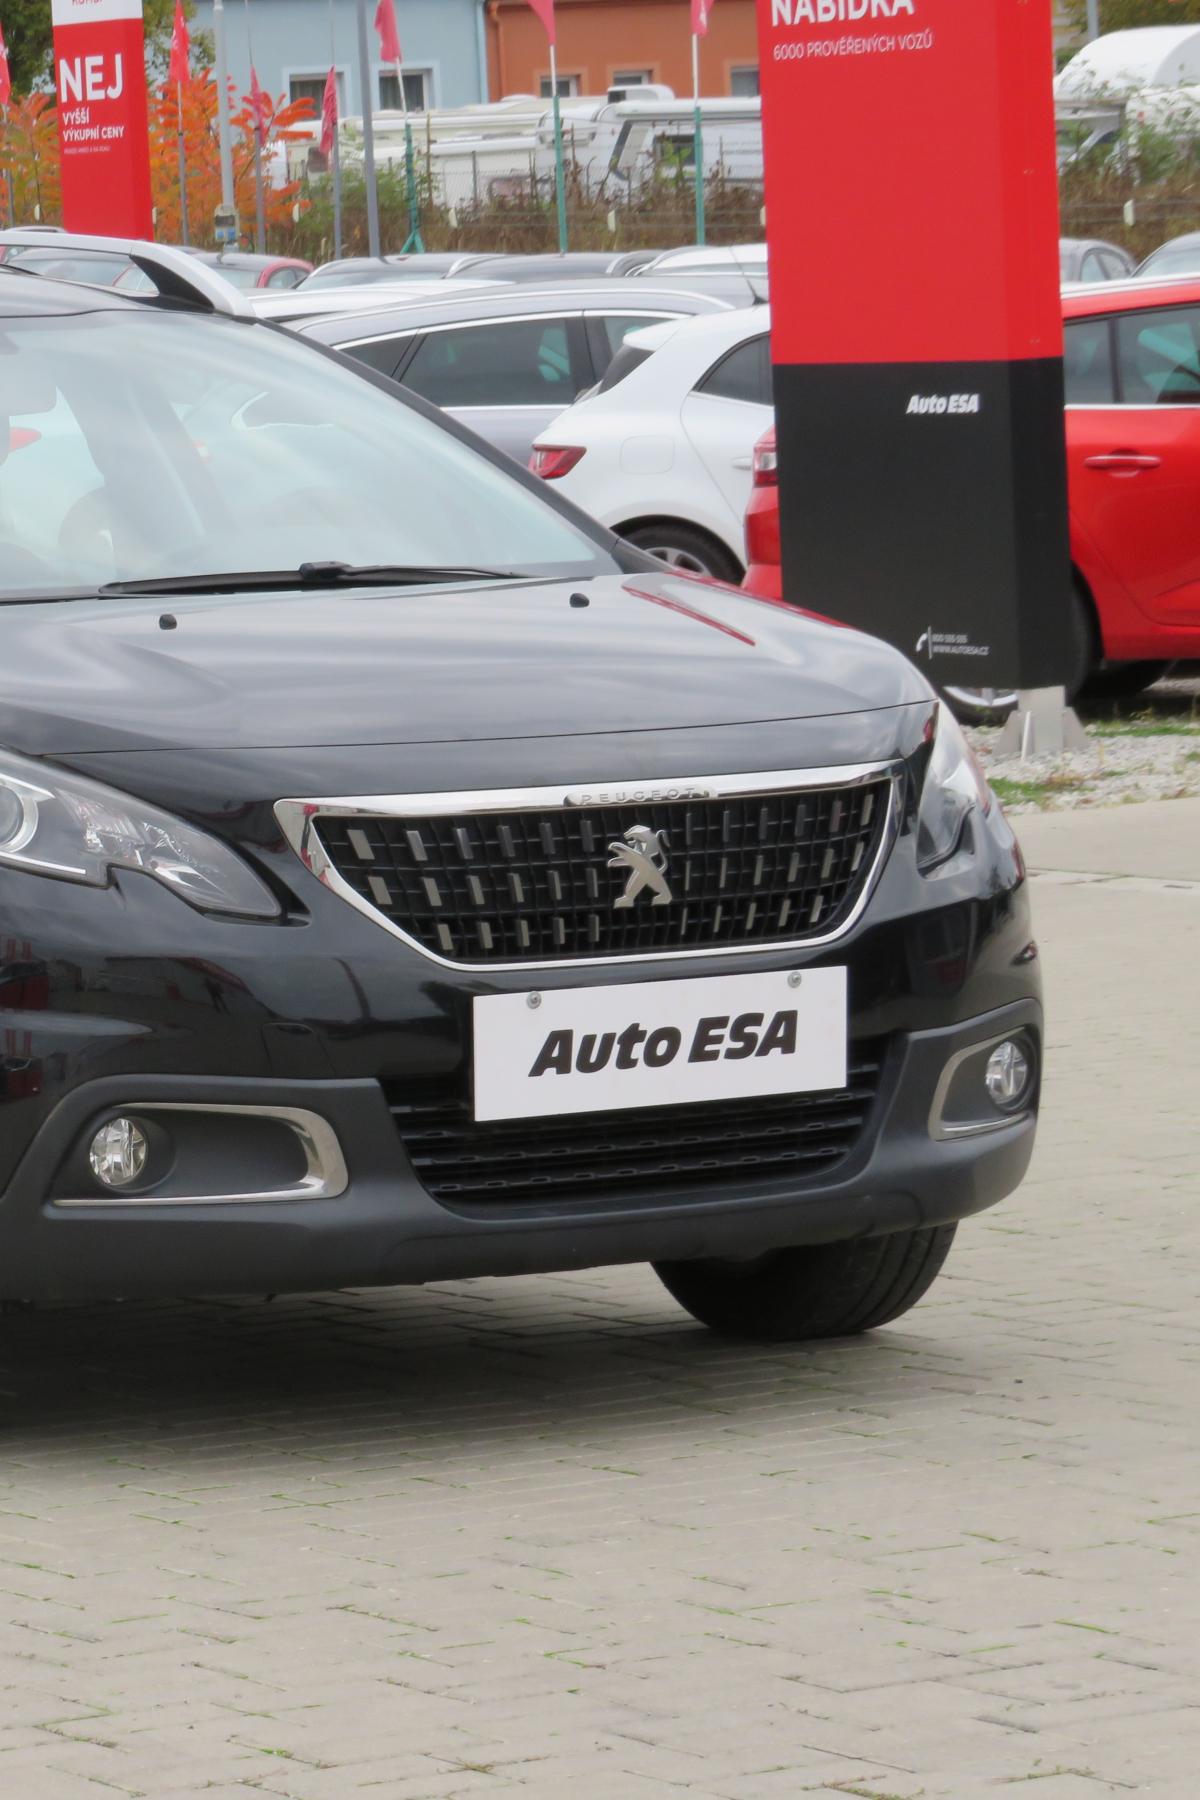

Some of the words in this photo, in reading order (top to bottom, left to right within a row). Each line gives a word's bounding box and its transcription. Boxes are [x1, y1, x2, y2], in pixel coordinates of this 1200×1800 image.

[773, 43, 804, 61] 6000
[59, 53, 123, 104] NEJ
[62, 124, 100, 142] VÝKUPNÍ
[101, 125, 125, 139] CENY
[905, 394, 948, 414] Auto
[947, 393, 980, 414] ESA
[581, 787, 696, 805] PEUGEOT
[528, 1023, 682, 1078] Auto
[688, 1009, 798, 1063] ESA
